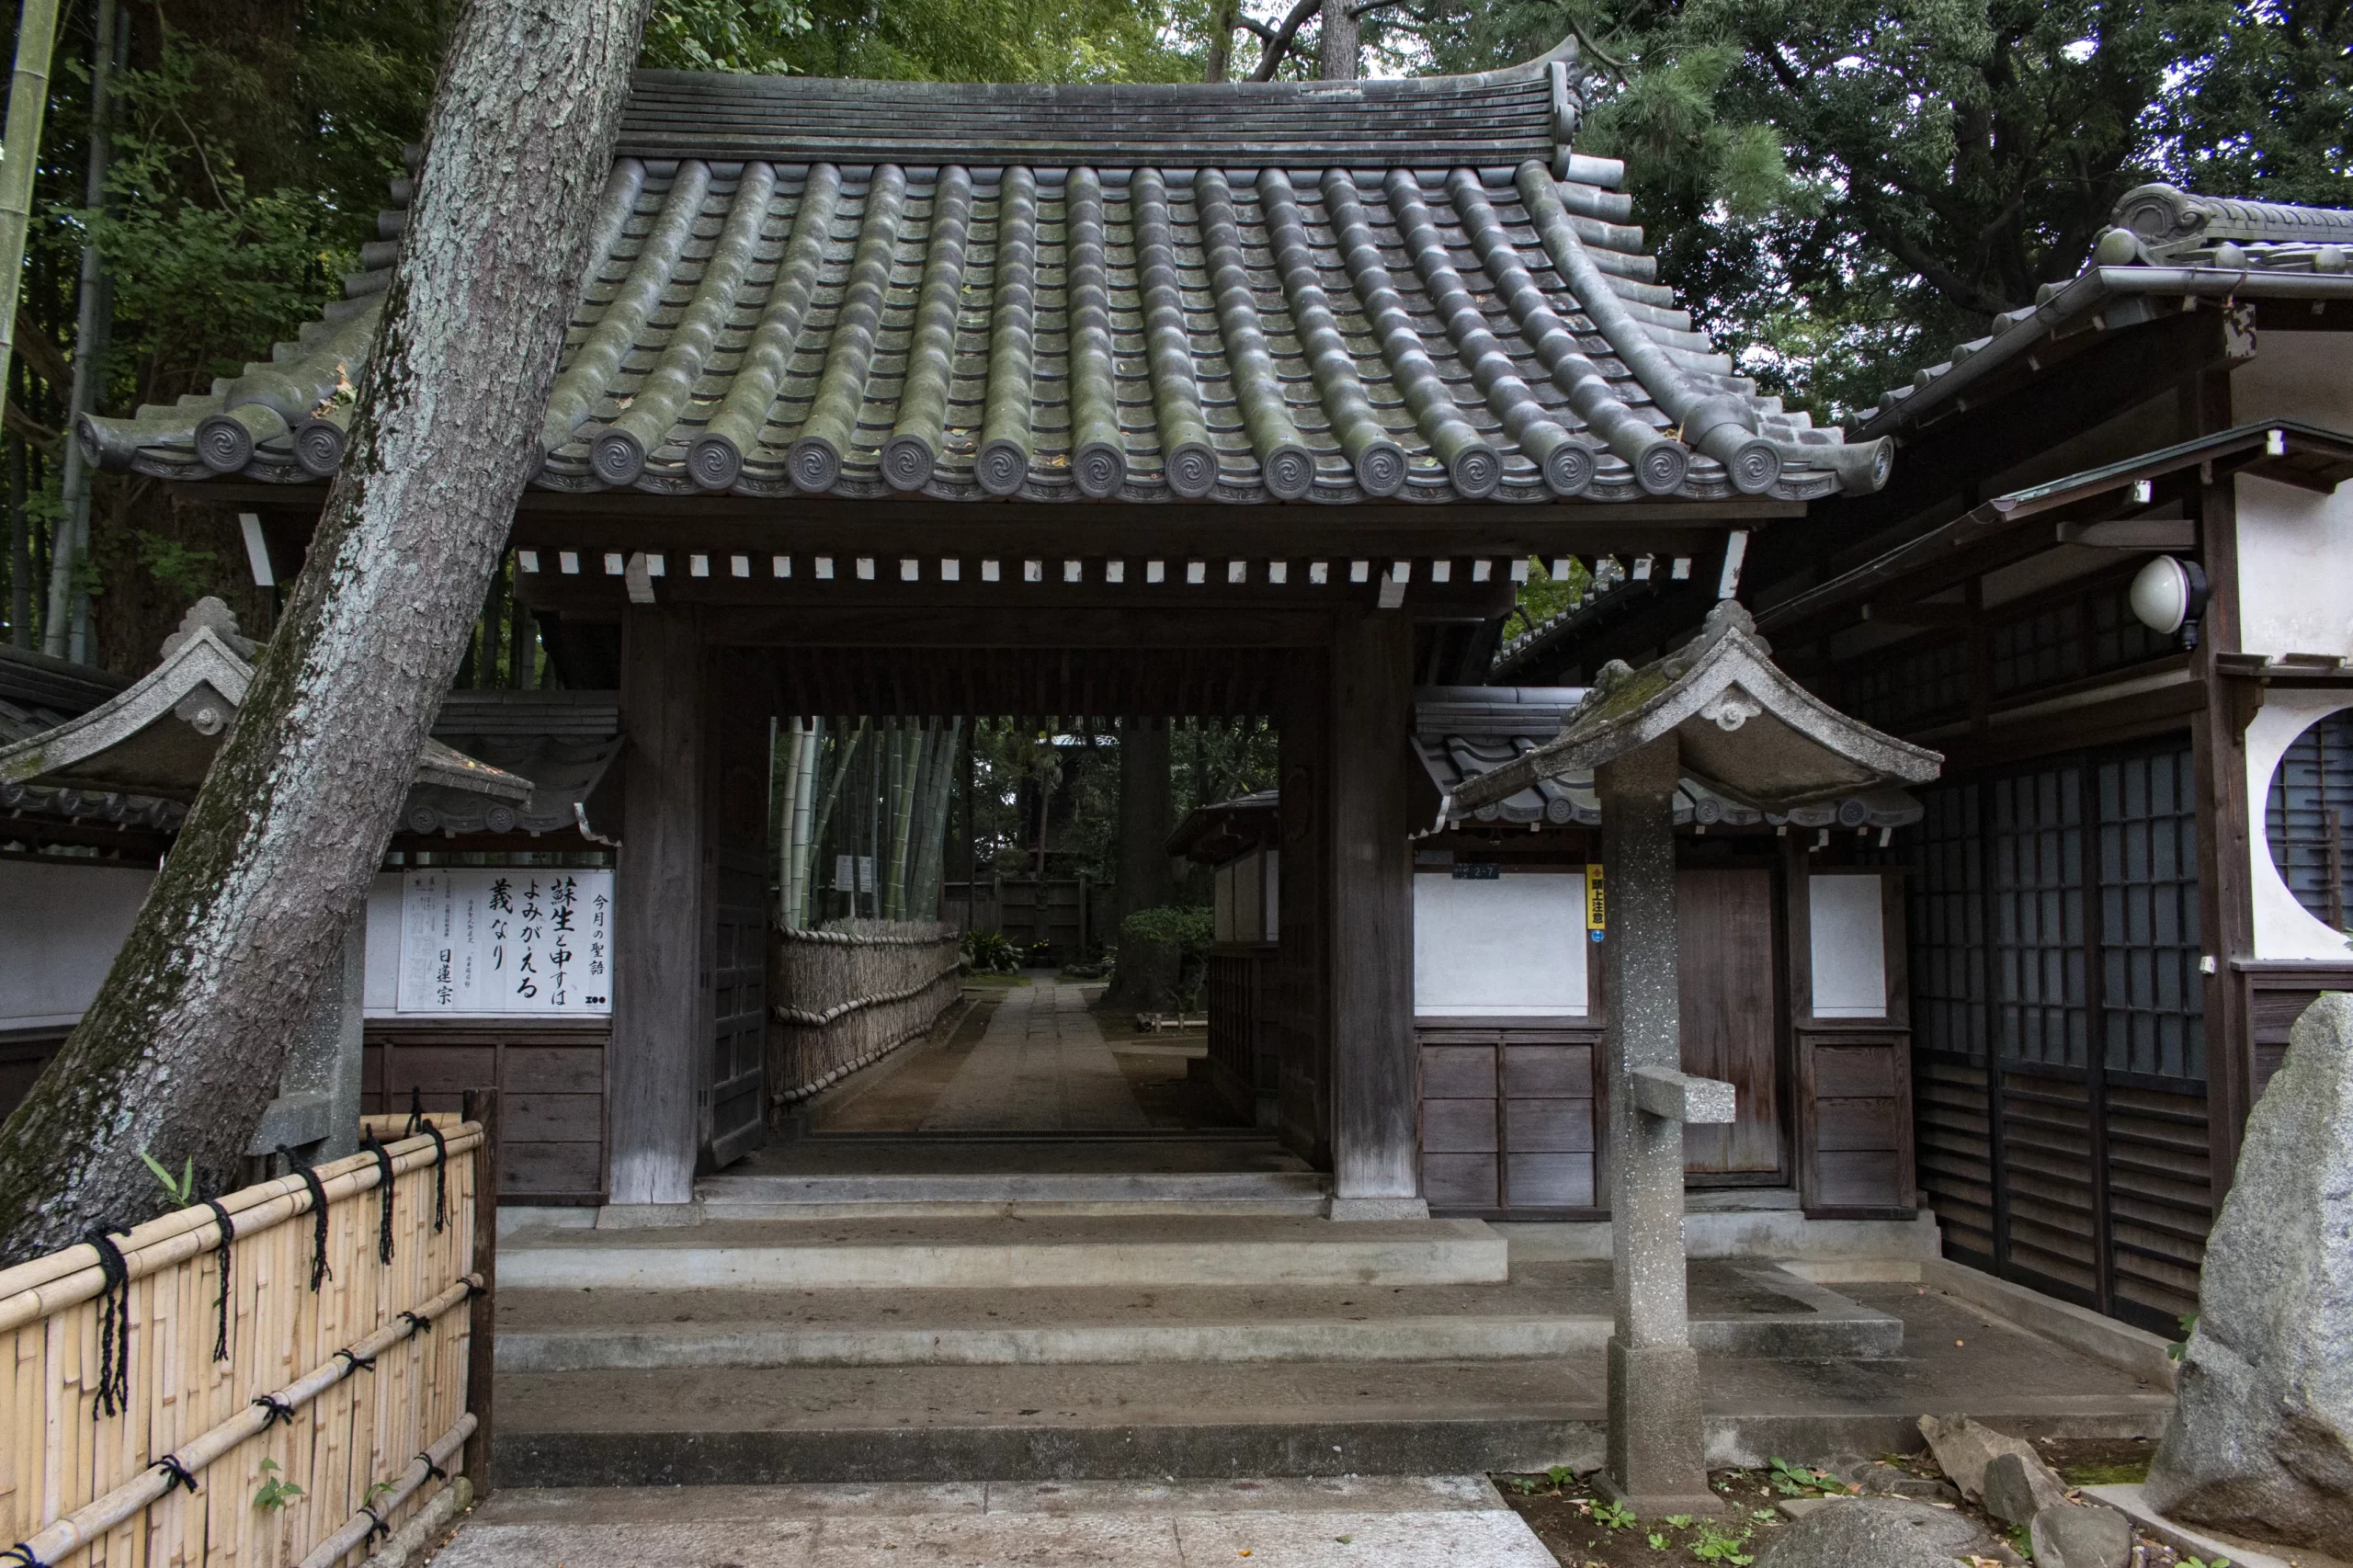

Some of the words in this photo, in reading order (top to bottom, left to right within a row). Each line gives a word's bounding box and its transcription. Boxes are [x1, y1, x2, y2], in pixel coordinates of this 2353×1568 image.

[1474, 867, 1494, 877] 2-7
[1592, 880, 1603, 924] 頭上注意
[489, 878, 513, 971] 義なり
[517, 879, 542, 998] よみがえる
[550, 876, 577, 1006] 蘇生と申すは
[589, 894, 608, 975] 今月の聖語
[437, 949, 452, 1005] 日蓮宗
